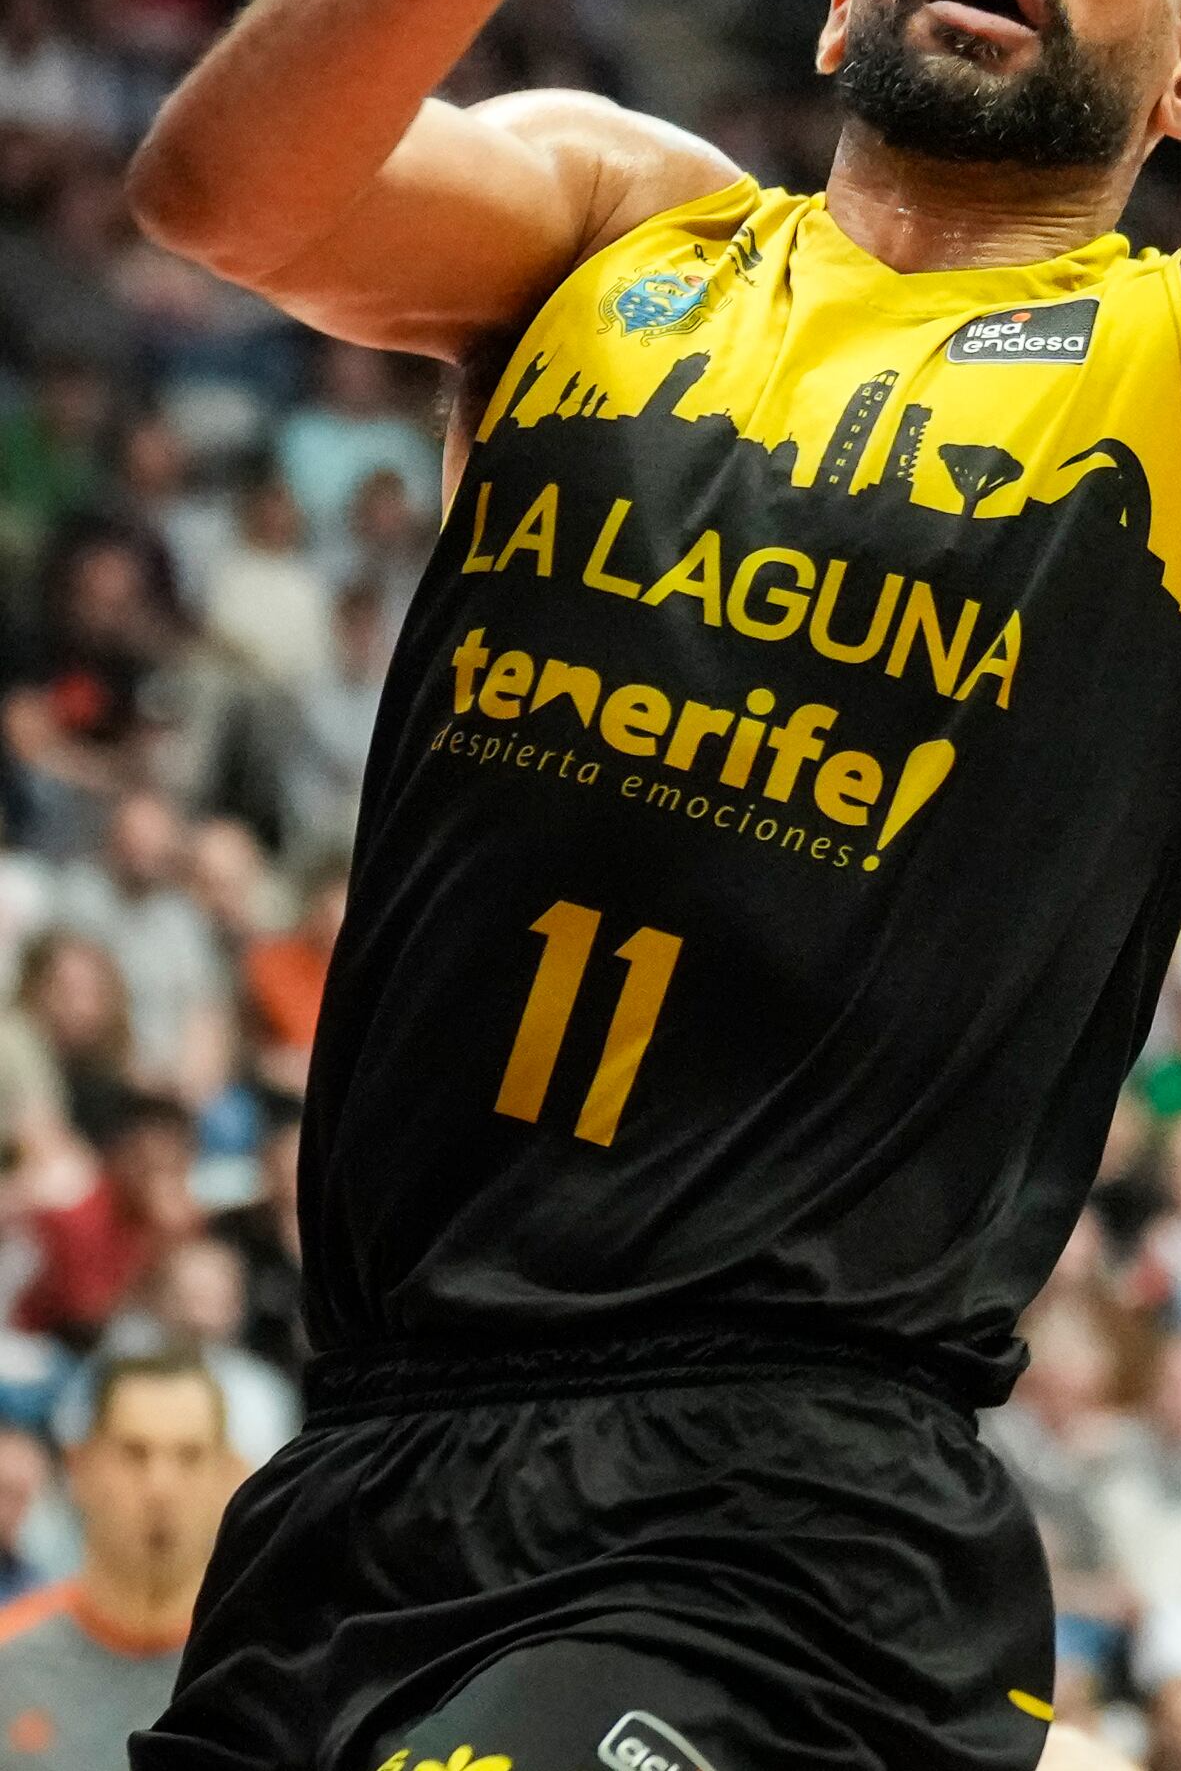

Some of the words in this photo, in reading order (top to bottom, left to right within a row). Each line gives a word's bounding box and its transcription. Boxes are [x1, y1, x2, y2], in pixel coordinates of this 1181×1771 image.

[962, 333, 1085, 354] endesa
[966, 322, 1023, 339] liga
[461, 481, 559, 578] LA
[582, 497, 1022, 710] LAGUNA
[430, 721, 602, 786] despierta
[620, 774, 854, 868] emociones
[494, 898, 684, 1148] 11
